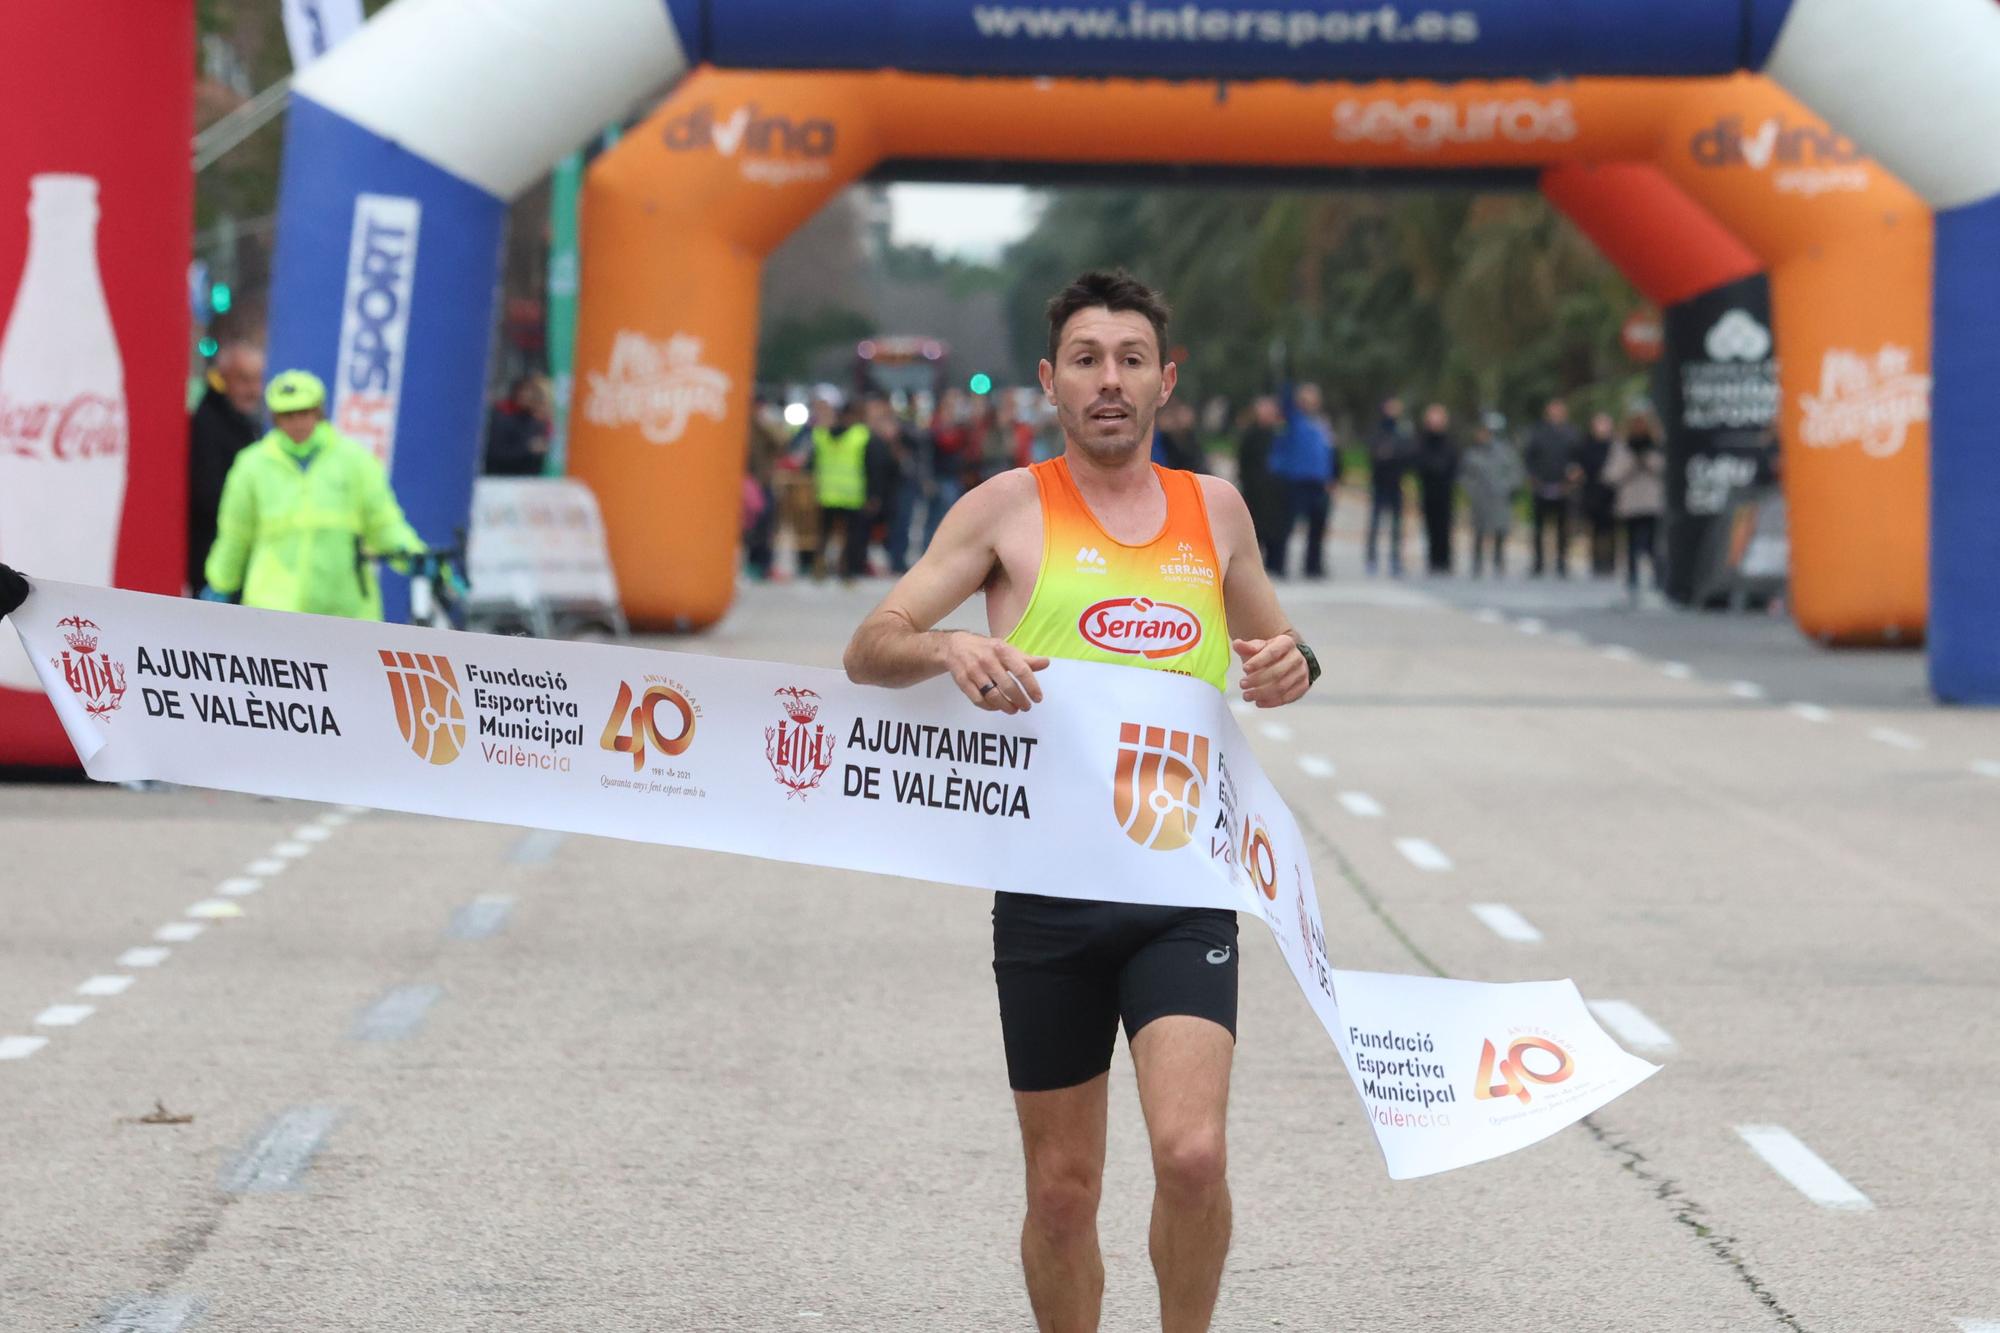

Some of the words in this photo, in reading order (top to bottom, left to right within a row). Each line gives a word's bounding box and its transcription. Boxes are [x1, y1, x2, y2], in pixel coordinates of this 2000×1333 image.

[973, 3, 1480, 47] www.intersport.es
[661, 101, 836, 157] divina
[1332, 98, 1577, 151] seguros
[1160, 564, 1214, 579] SERRANO
[1091, 611, 1193, 641] Serrano
[137, 646, 328, 692] AJUNTAMENT
[465, 664, 567, 691] Fundació
[141, 687, 184, 719] DE
[190, 691, 342, 736] VALÈNCIA
[474, 688, 578, 718] Esportiva
[479, 714, 583, 749] Municipal
[599, 680, 696, 773] 40
[481, 741, 571, 772] València
[847, 717, 1038, 770] AJUNTAMENT
[676, 770, 692, 779] 2021
[843, 764, 880, 800] DE
[892, 768, 1031, 819] VALÈNCIA
[1349, 1026, 1434, 1053] Fundació
[1356, 1052, 1445, 1080] Esportiva
[1473, 1037, 1575, 1106] 40
[1362, 1078, 1456, 1109] Municipal
[1368, 1104, 1451, 1128] València
